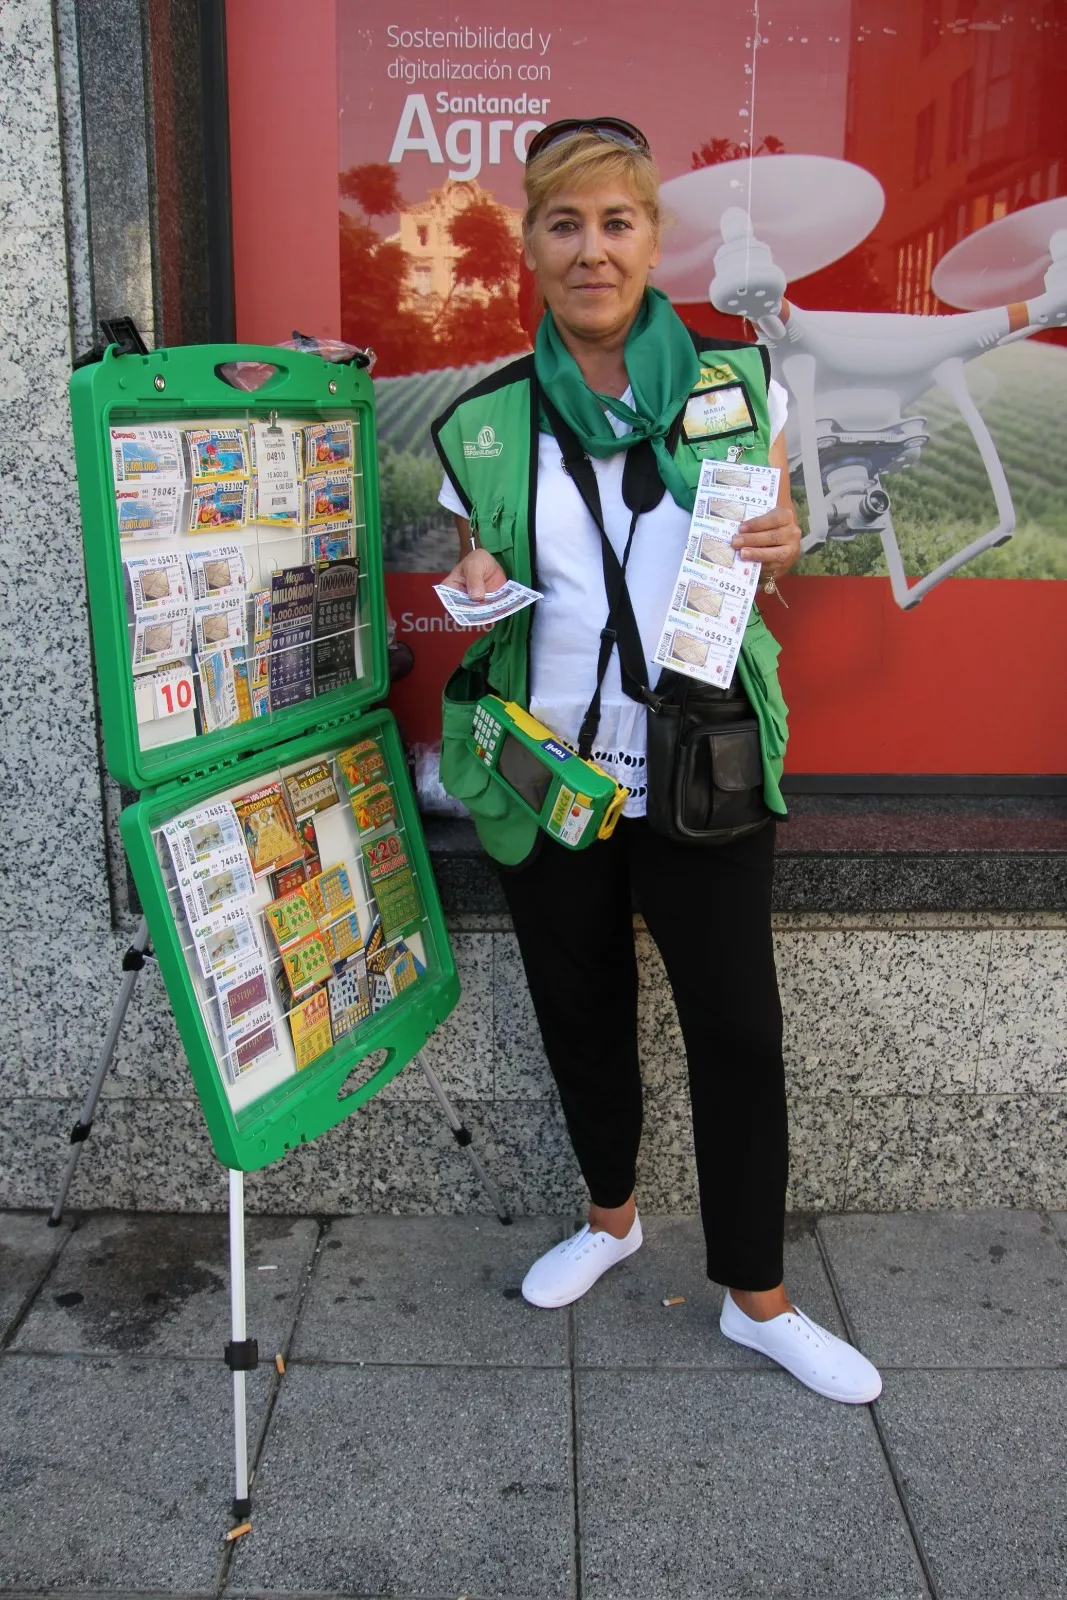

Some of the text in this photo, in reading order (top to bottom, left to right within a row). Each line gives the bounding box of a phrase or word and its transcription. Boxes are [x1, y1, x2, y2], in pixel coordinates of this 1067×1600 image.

[387, 25, 551, 56] Sostenibilidad y
[387, 58, 551, 84] digitalización con
[436, 91, 551, 114] Santander
[284, 571, 304, 585] Mega
[719, 580, 747, 597] 65473
[401, 612, 495, 633] Sant
[704, 630, 733, 646] 65473
[161, 680, 191, 713] 10
[555, 791, 570, 821] ONCE
